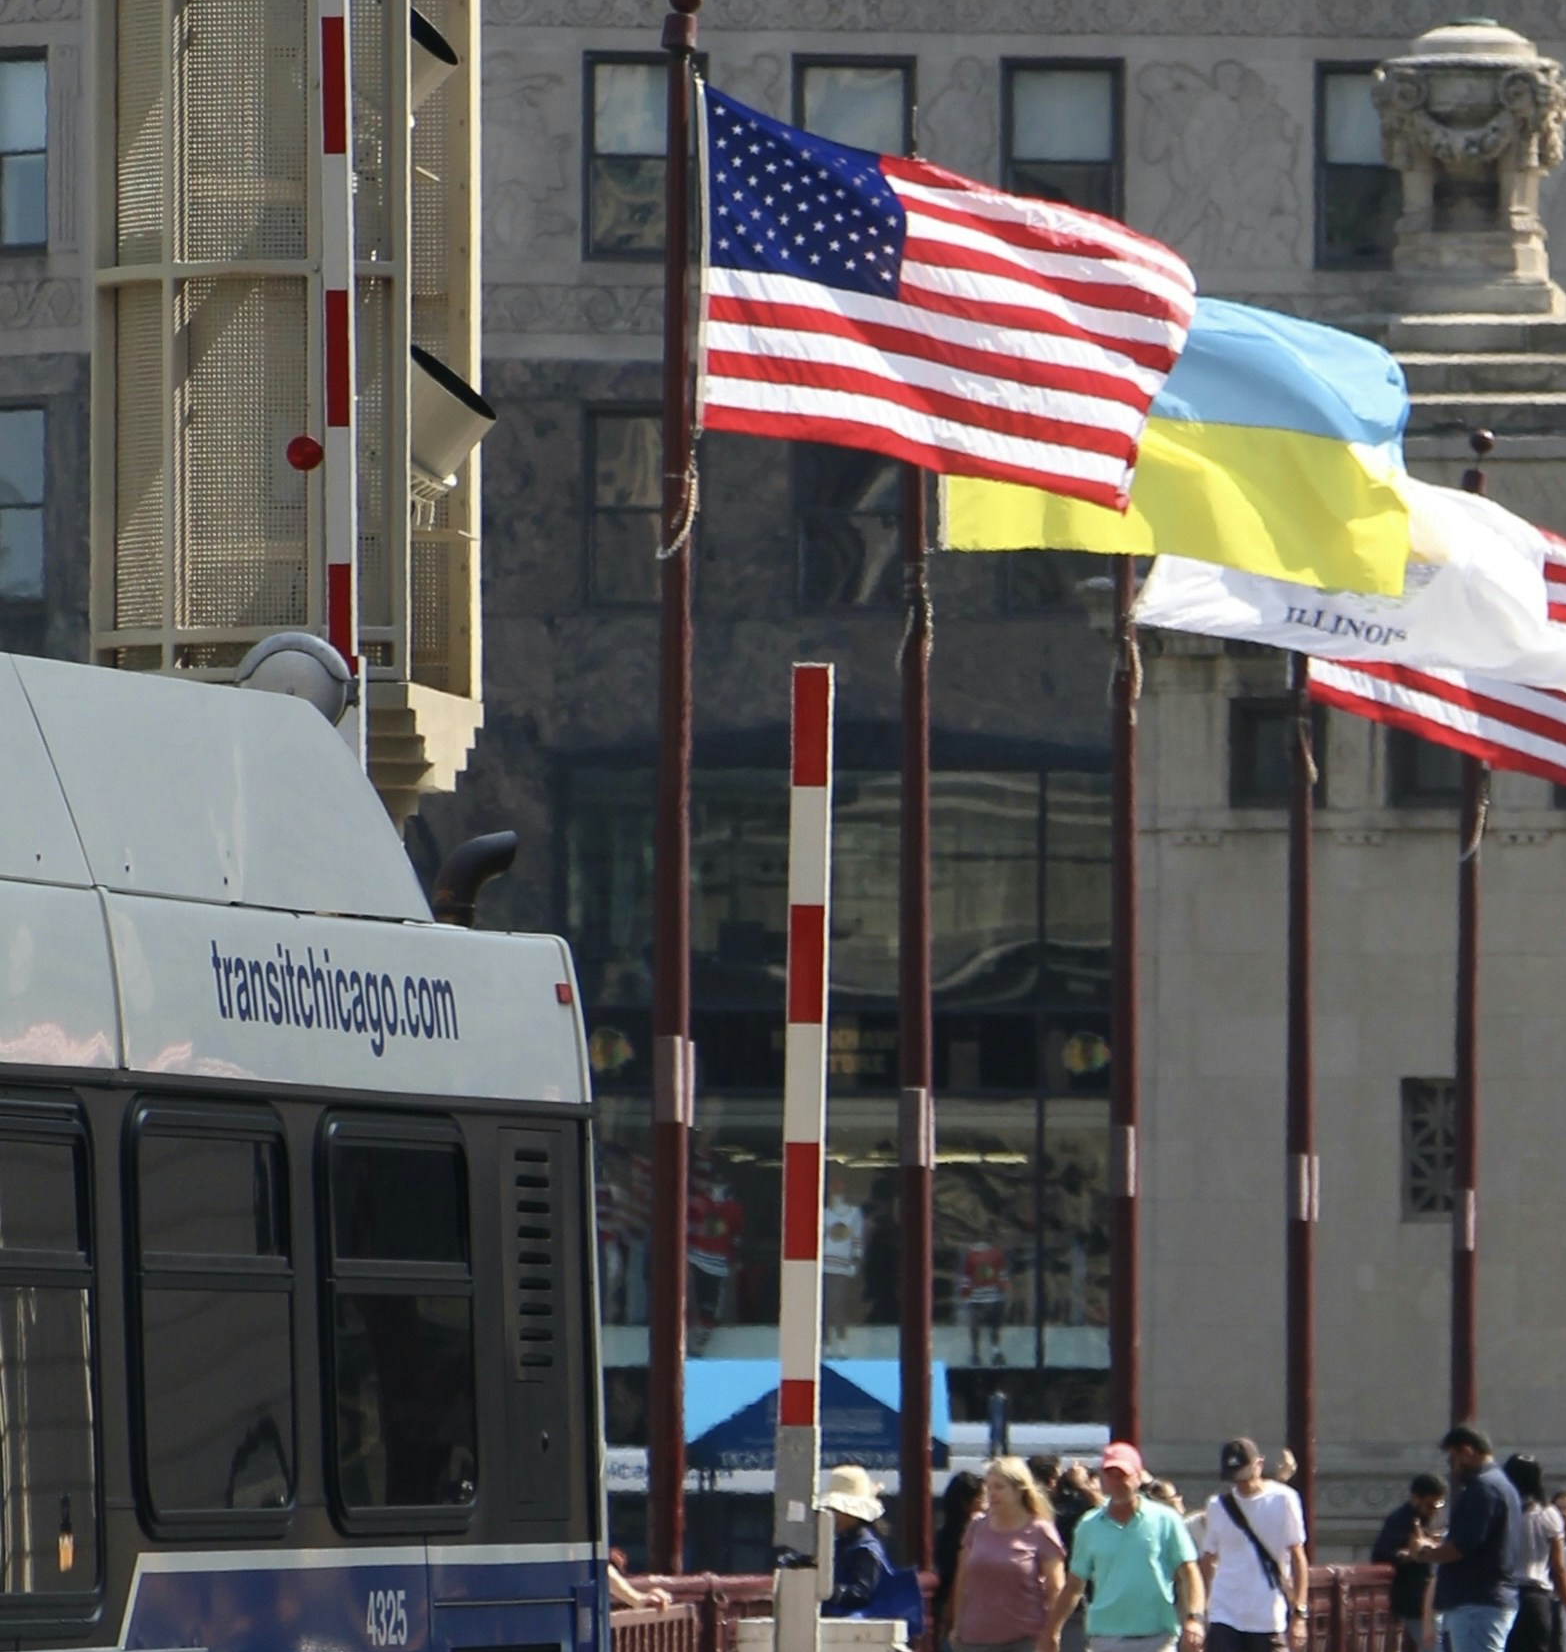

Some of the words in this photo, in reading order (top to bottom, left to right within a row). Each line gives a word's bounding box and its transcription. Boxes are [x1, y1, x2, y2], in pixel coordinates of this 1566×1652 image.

[1284, 606, 1408, 645] ILLINOIS
[210, 939, 459, 1058] transitchicago.com
[367, 1589, 408, 1647] 4325
